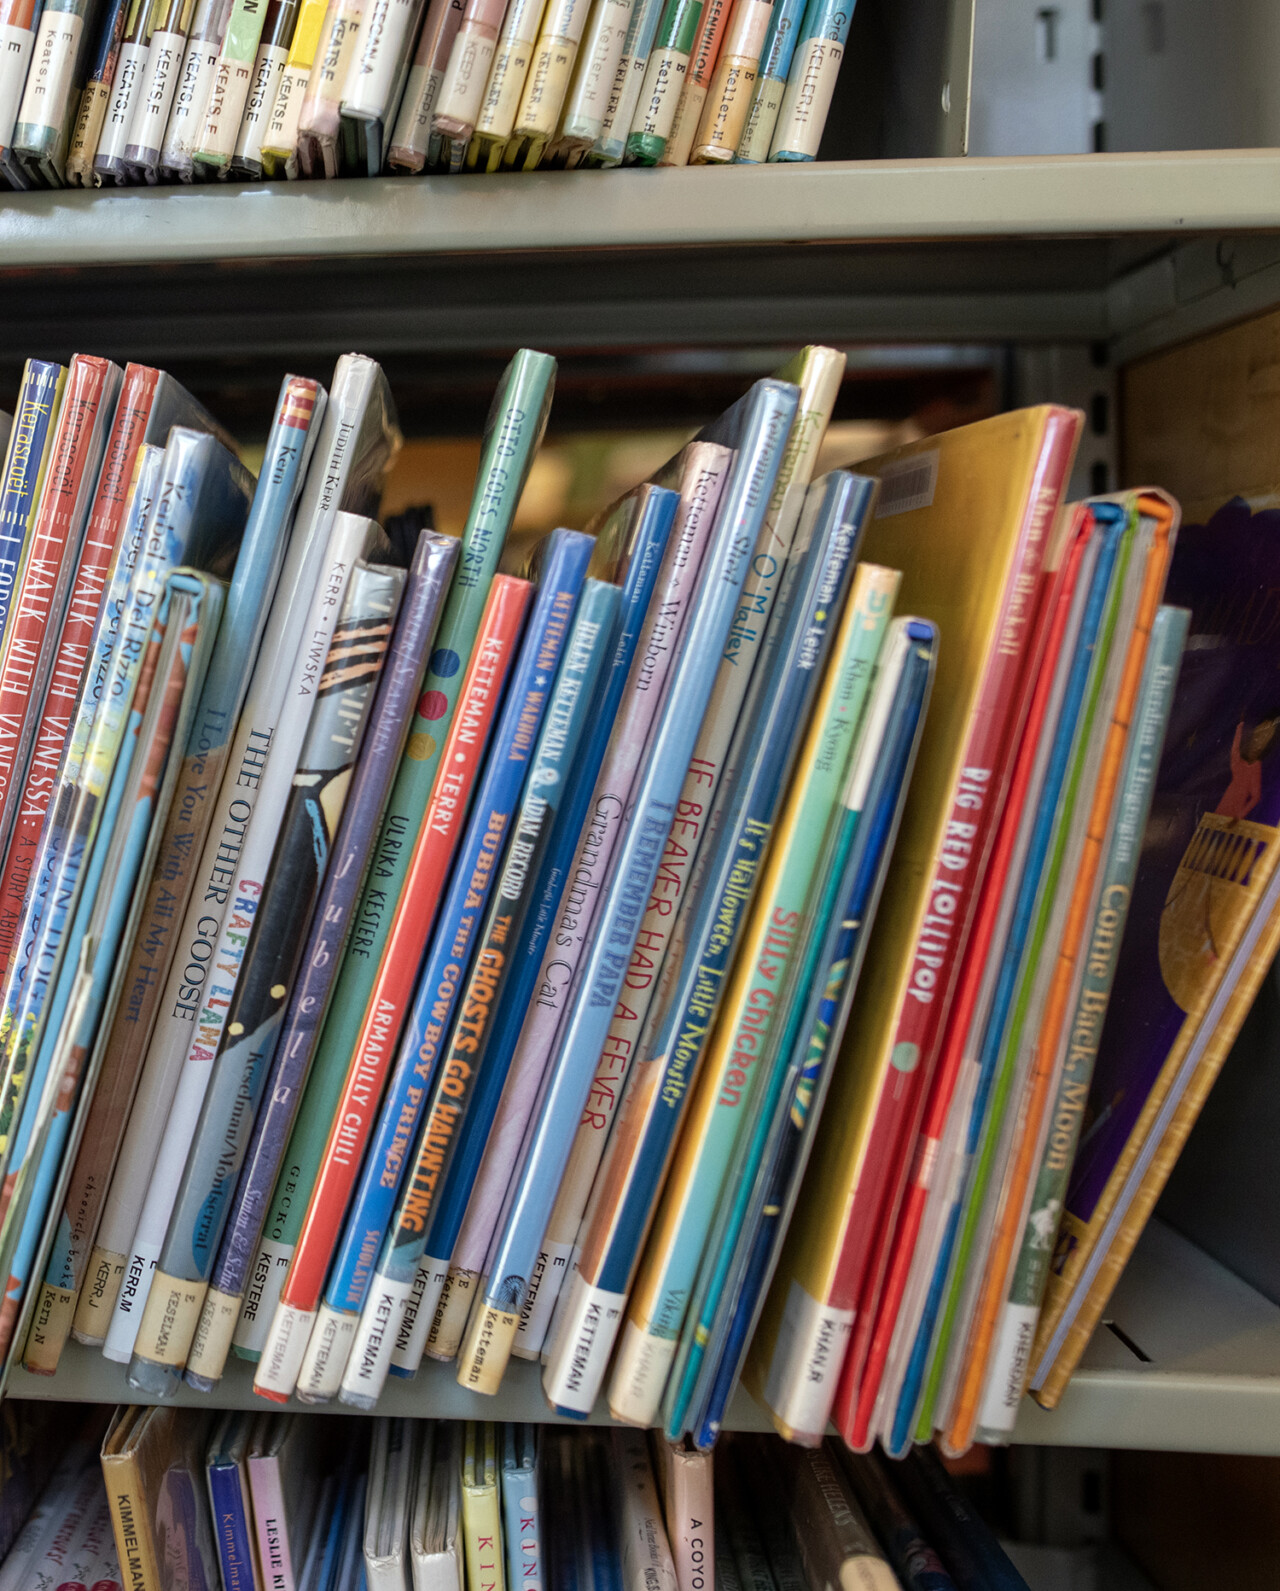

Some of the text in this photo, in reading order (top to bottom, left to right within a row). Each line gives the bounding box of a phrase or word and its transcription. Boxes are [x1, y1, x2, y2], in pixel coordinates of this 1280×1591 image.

[112, 59, 138, 124] KEATS,E
[146, 49, 172, 115] KEATS,E
[176, 51, 203, 117] KEATS,E
[206, 64, 230, 134] KEATS,E
[245, 58, 274, 123] KEATS,E
[643, 60, 674, 135] Keller,H
[710, 68, 741, 142] Keller,H
[9, 400, 50, 497] Kerascoët
[271, 444, 299, 486] Kern
[318, 421, 355, 512] JUDITH KERR
[457, 407, 526, 588] OTTO GOES NORTH
[636, 468, 720, 693] Ketteman Winborn
[796, 523, 856, 671] Ketteman Leick
[998, 486, 1057, 657] Khan Blackall
[297, 561, 346, 697] KERR LIWSKA
[509, 591, 574, 761] KETTEMAN WARHOLA
[20, 562, 108, 827] WALK WITH VANESSA:
[430, 637, 505, 836] KETTEMAN TERRY
[172, 726, 275, 1022] THE OTHER GOOSE
[352, 814, 410, 960] ULRIKA KESTERE
[536, 792, 623, 1010] Grandma's Cat
[920, 766, 992, 1005] BIG RED LOLLIPOP
[188, 878, 264, 1064] CRAFTY LLAMA
[580, 757, 716, 1132] IF BEAVER HAD A FEVER
[1089, 884, 1131, 979] Come
[378, 810, 508, 1189] BUBBA THE COWBOY PRINCE
[721, 906, 799, 1109] Silly Chicken
[332, 999, 396, 1166] ARMADILLY CHILI
[1046, 1078, 1088, 1172] Moon
[119, 1255, 146, 1314] KERR,M
[244, 1253, 273, 1322] KESTERE
[358, 1294, 395, 1381] KETTEMAN
[466, 1312, 499, 1384] Ketteman
[565, 1303, 602, 1393] KETTEMAN
[805, 1319, 837, 1384] KHAN,R
[117, 1494, 145, 1591] KIMMELMAN
[266, 1519, 284, 1569] LESLIE
[690, 1518, 703, 1530] A
